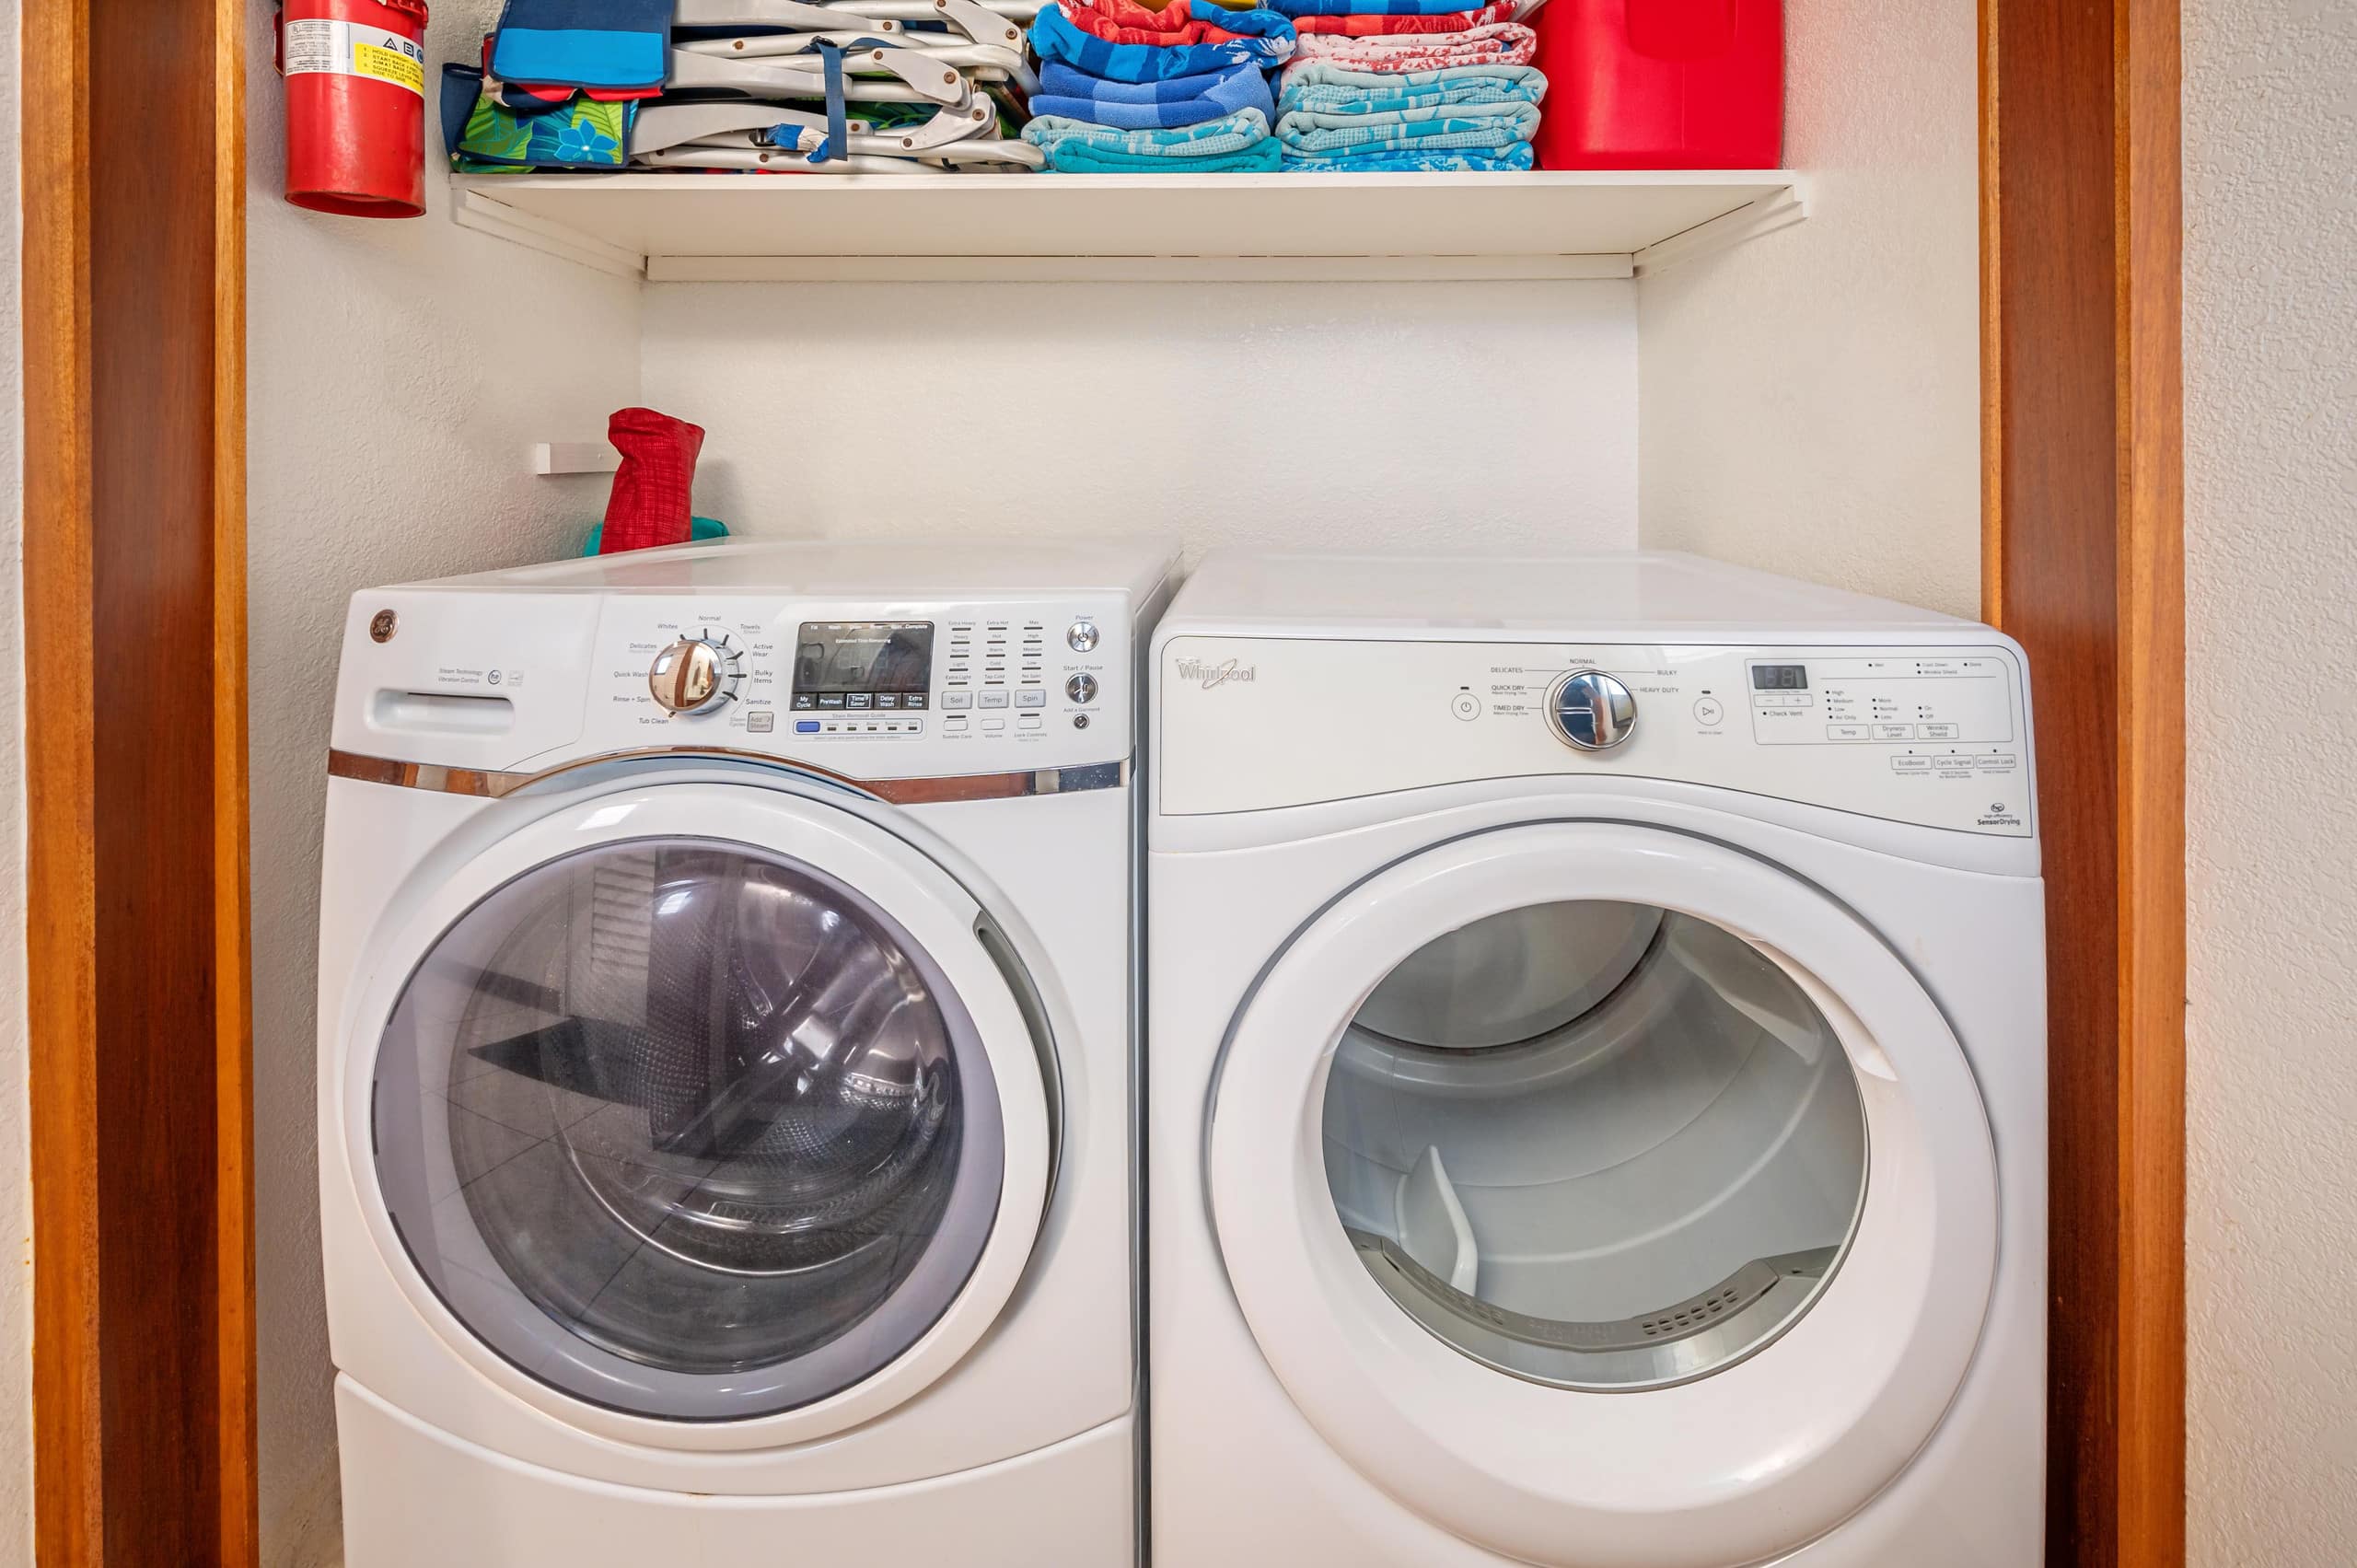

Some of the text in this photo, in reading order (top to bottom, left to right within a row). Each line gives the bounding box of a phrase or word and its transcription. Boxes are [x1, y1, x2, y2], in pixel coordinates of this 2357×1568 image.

[755, 669, 773, 678] Bulky
[1178, 661, 1256, 685] Whirlpool
[984, 696, 1003, 704] Temp
[1022, 694, 1039, 703] Spin
